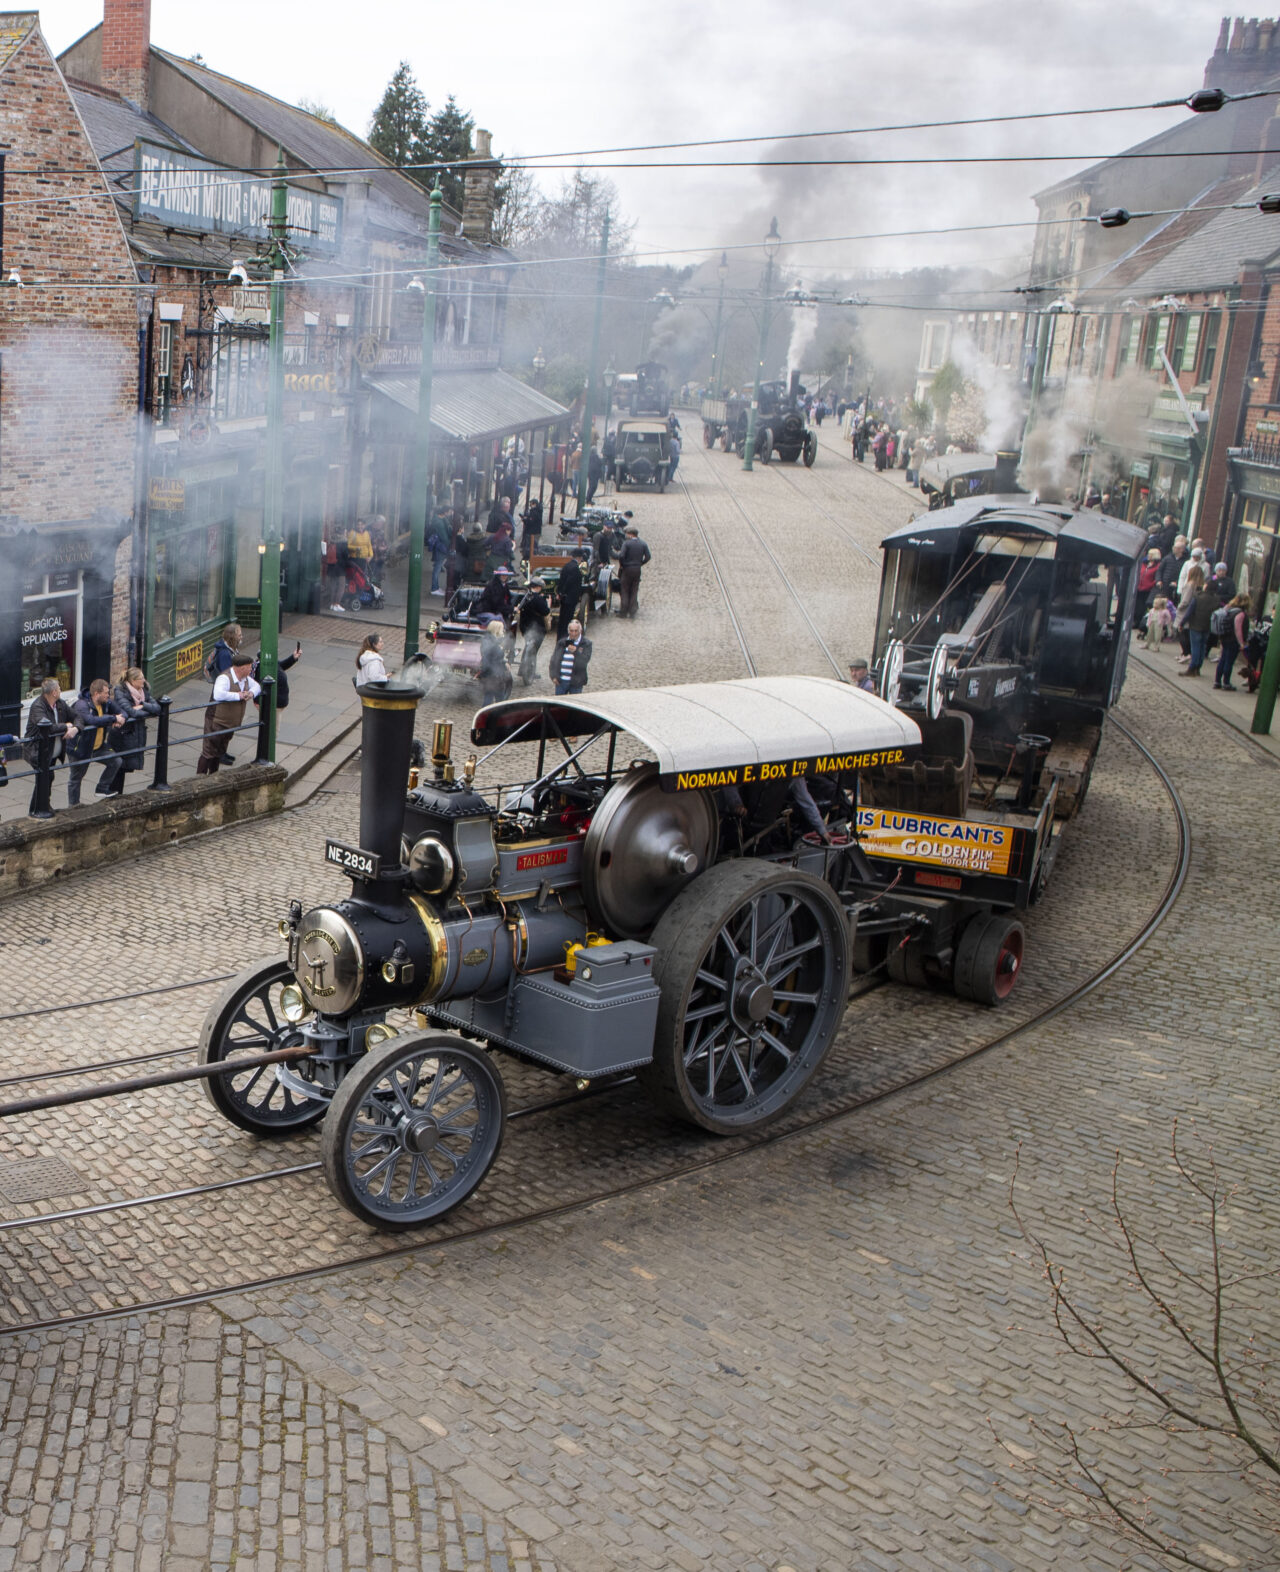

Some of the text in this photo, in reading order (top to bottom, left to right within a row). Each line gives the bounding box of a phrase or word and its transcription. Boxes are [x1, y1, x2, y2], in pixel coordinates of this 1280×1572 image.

[141, 154, 200, 216] BEAMISH
[202, 172, 241, 224] MOTOR
[256, 373, 337, 393] GRAGE
[23, 616, 64, 632] SURGICAL
[677, 768, 737, 791] NORMAN
[743, 765, 756, 783] E.
[760, 760, 787, 781] BOX
[880, 813, 1005, 845] LUBRICANTS
[328, 845, 373, 874] NE 2834
[901, 838, 970, 860] GOLDEN
[971, 848, 993, 861] FILM
[941, 857, 991, 871] MOTOR OIL
